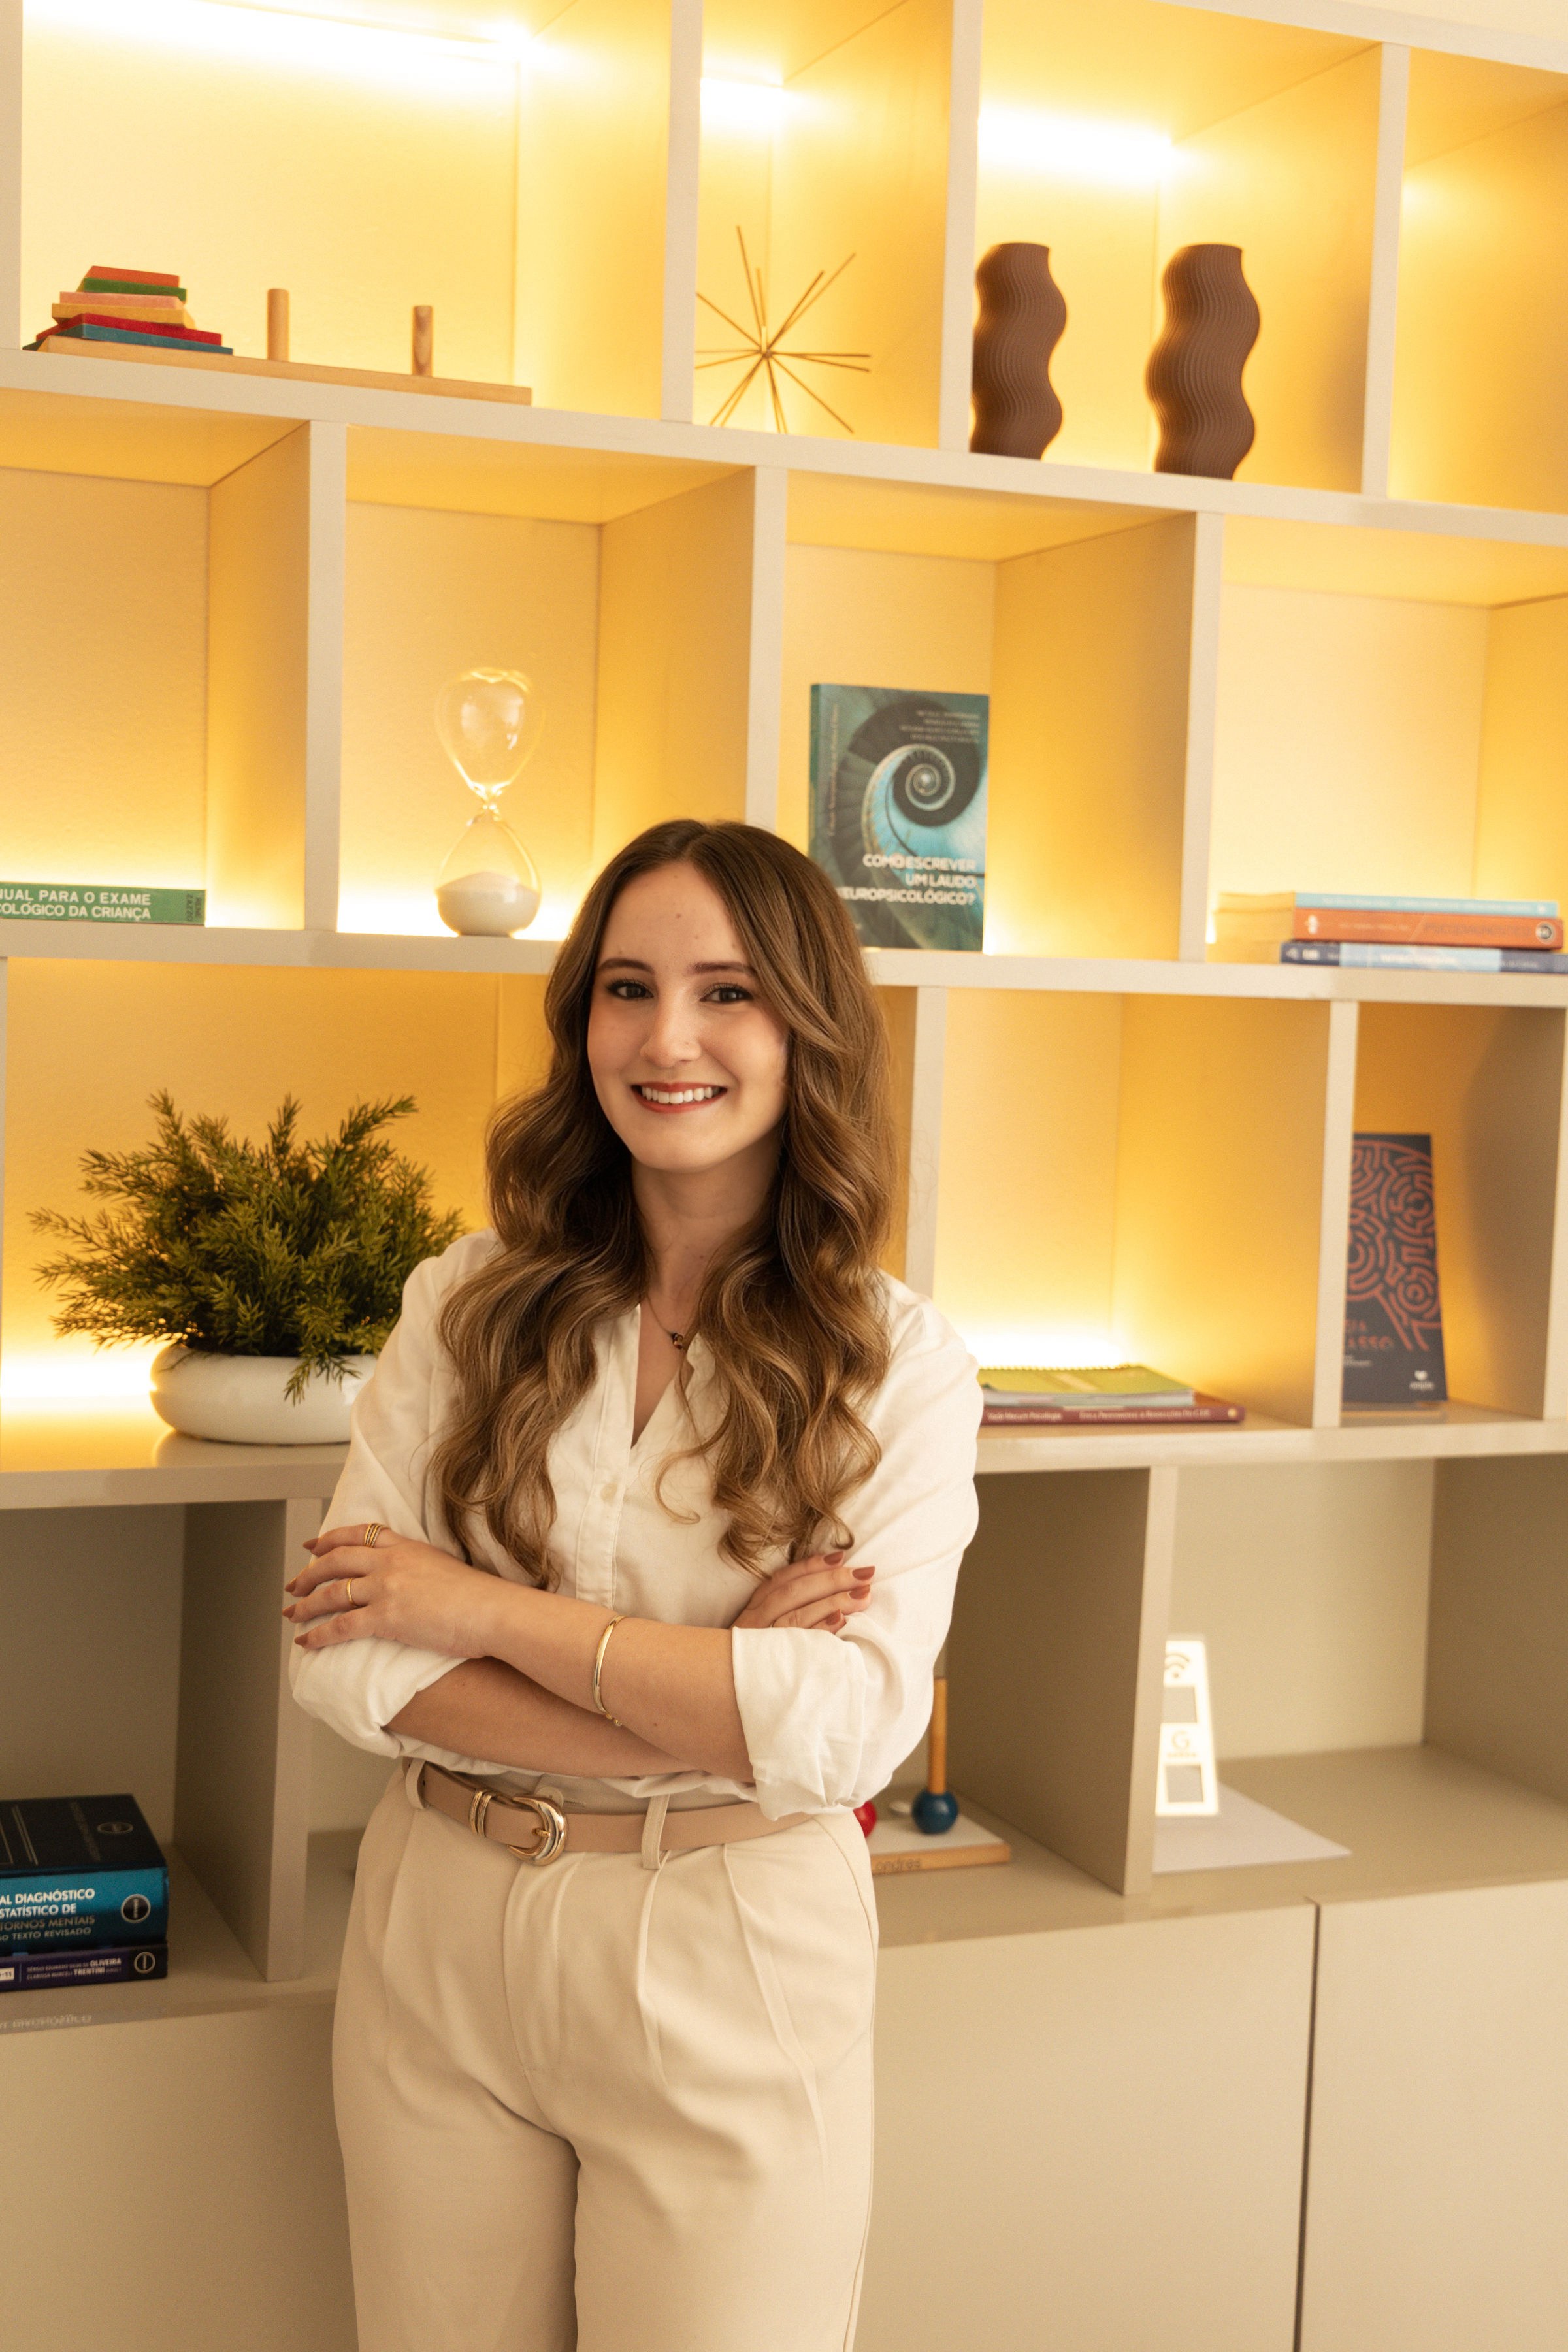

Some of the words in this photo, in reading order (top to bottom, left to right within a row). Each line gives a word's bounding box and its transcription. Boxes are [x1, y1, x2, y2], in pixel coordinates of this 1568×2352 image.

[862, 854, 905, 870] COMO
[906, 856, 975, 872] ESCREVER
[906, 873, 928, 885] UM
[929, 874, 975, 888] LAUDO
[39, 890, 80, 902] PARA
[84, 891, 96, 904] O
[100, 891, 152, 906] EXAME
[69, 905, 88, 917] DA
[91, 906, 152, 921] CRIANÇA
[0, 1894, 12, 1906] AL
[15, 1888, 95, 1904] DIAGNÓSTICO
[62, 1903, 77, 1914] DE
[48, 1916, 95, 1927] MENTAIS
[13, 1931, 41, 1940] TEXTO
[44, 1927, 91, 1938] REVISADO
[90, 1957, 122, 1967] OLIVEIRA
[73, 1967, 105, 1976] TRENTINI
